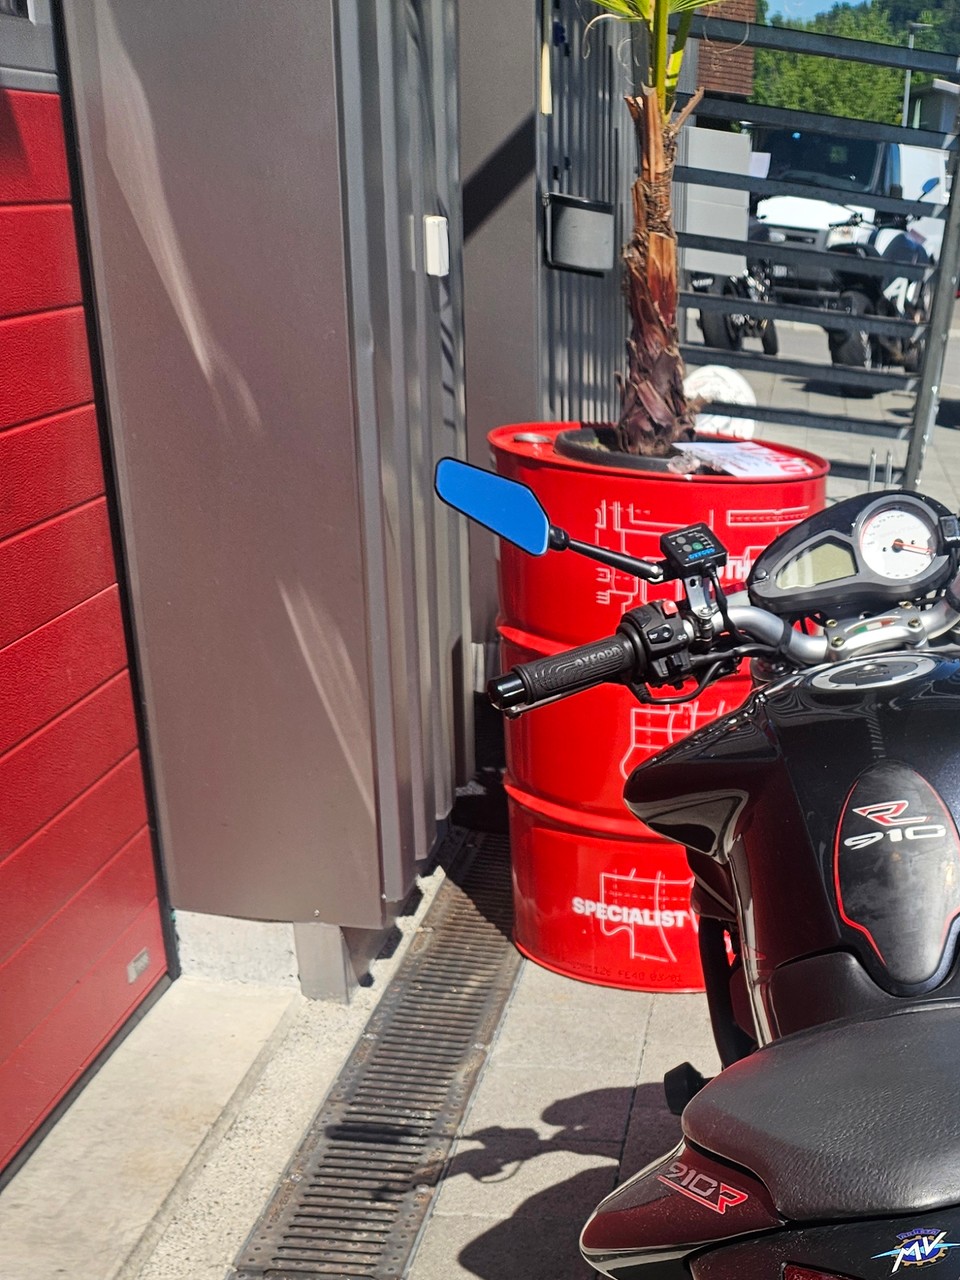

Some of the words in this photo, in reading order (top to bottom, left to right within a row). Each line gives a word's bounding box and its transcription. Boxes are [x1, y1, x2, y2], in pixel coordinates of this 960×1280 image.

[852, 800, 931, 826] R
[844, 824, 947, 850] 910
[571, 896, 687, 928] SPECIALIST
[891, 1231, 947, 1273] MV
